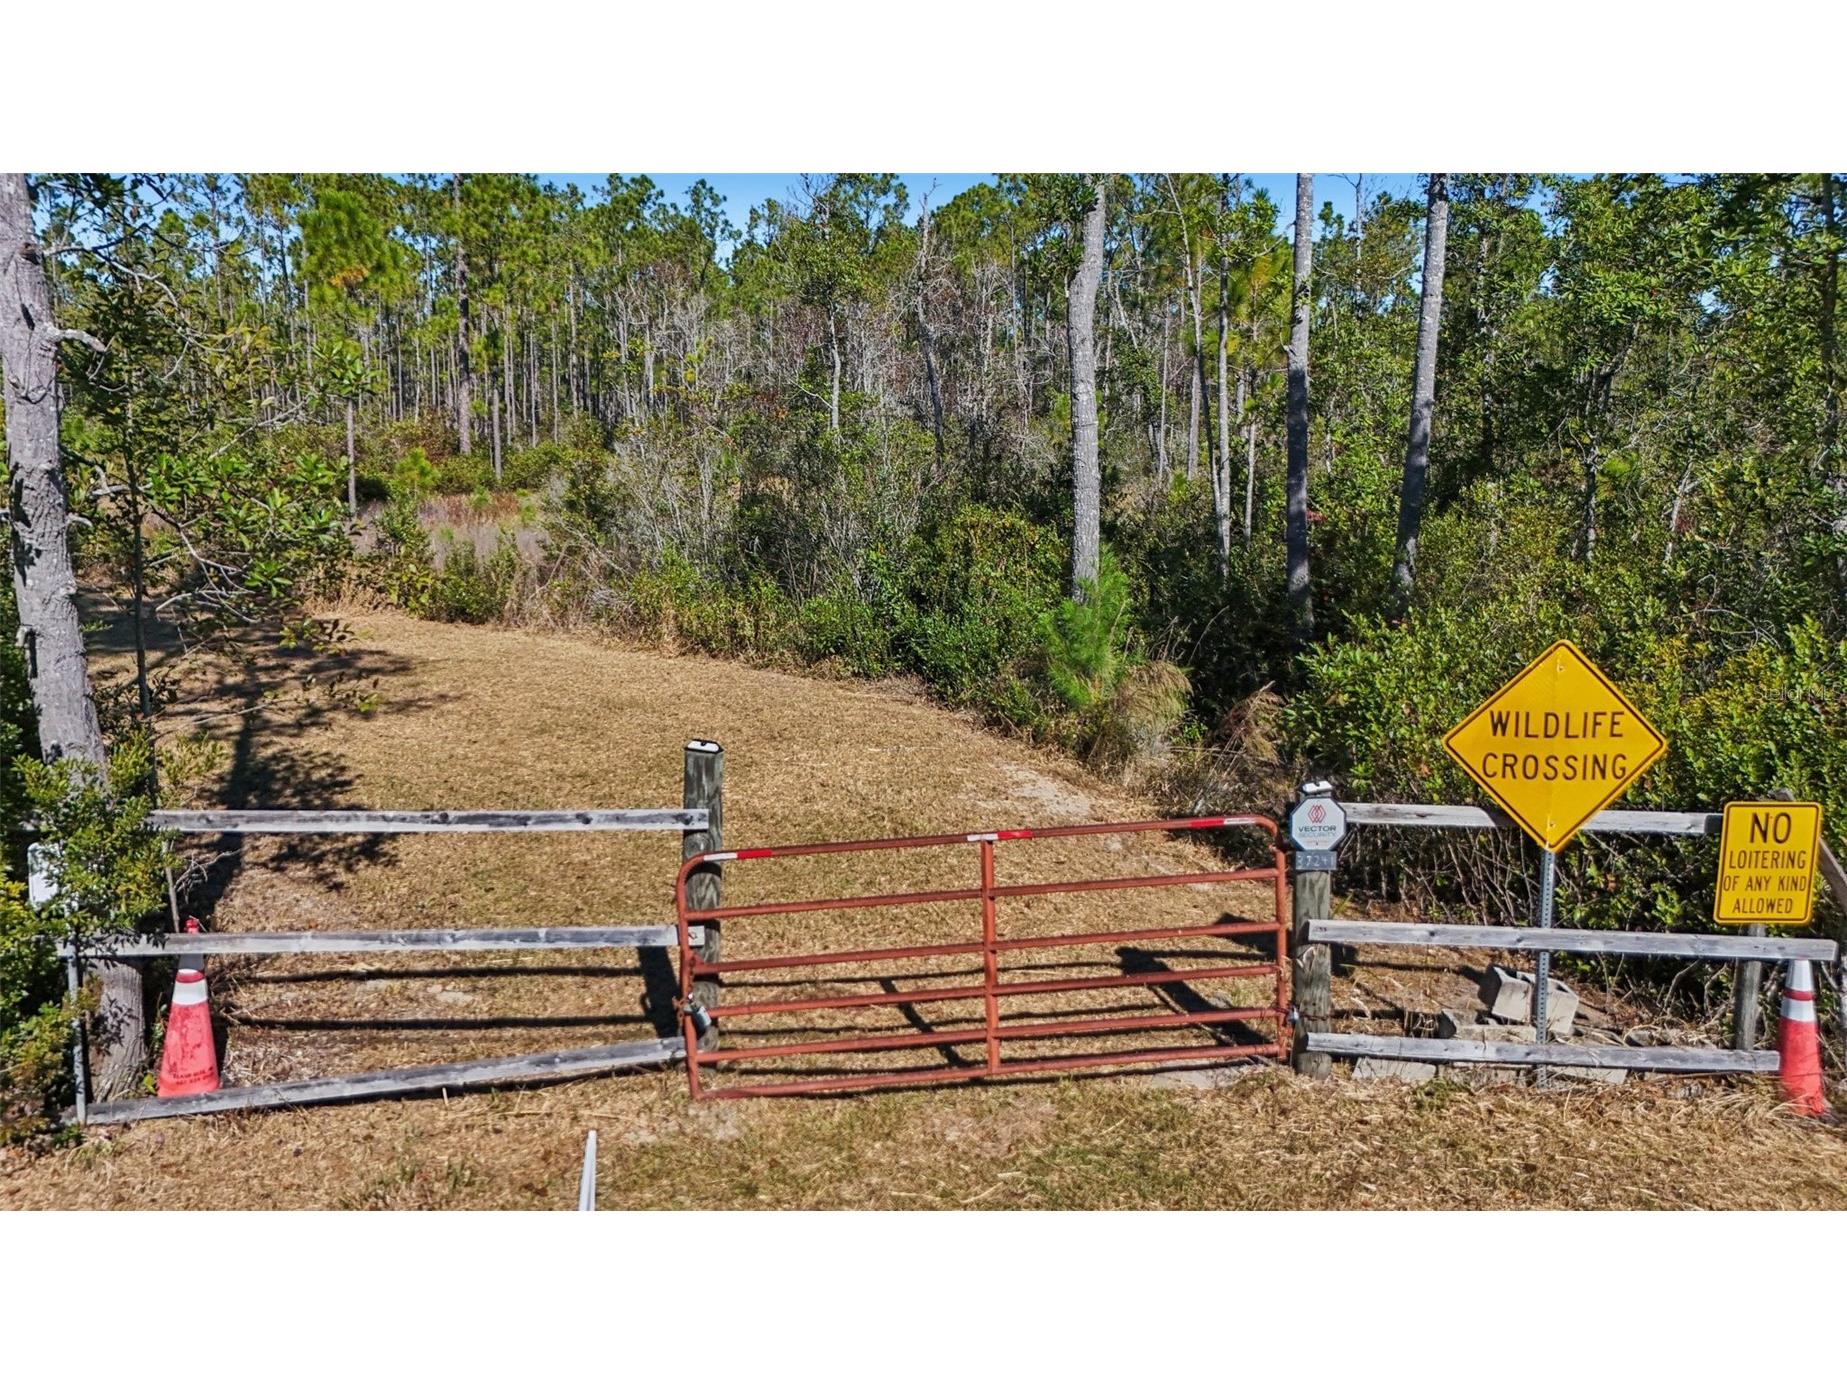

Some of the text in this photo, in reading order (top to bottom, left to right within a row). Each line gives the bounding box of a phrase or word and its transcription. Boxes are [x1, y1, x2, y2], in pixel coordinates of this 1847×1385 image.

[1489, 710, 1625, 739] WILDLIFE
[1482, 752, 1628, 781] CROSSING
[1749, 811, 1792, 844] NO
[1728, 850, 1807, 869] LOITERING
[1723, 875, 1807, 892] OF ANY KIND
[1732, 898, 1793, 914] ALLOWED
